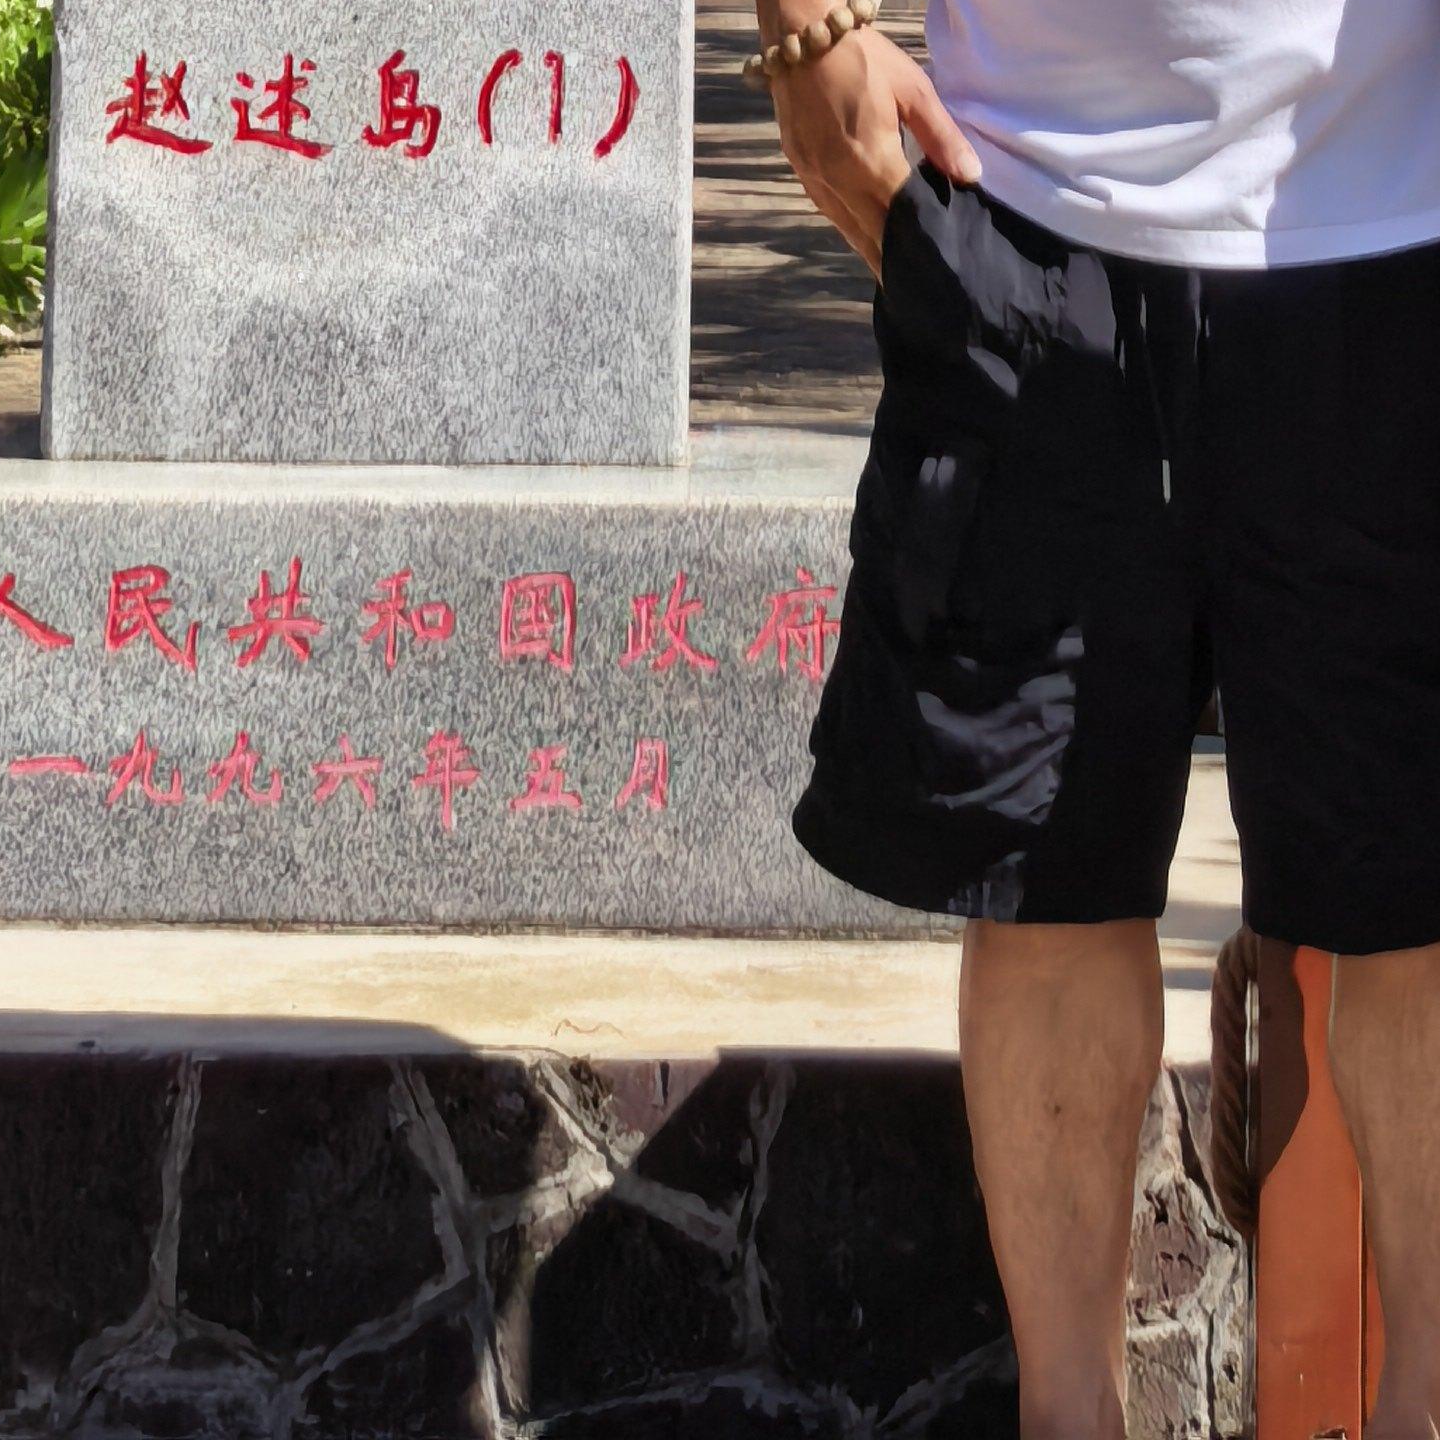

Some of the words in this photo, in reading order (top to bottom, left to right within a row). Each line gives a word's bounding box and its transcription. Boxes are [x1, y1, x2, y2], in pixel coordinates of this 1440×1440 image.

[8, 729, 671, 831] 一九九六年五月
